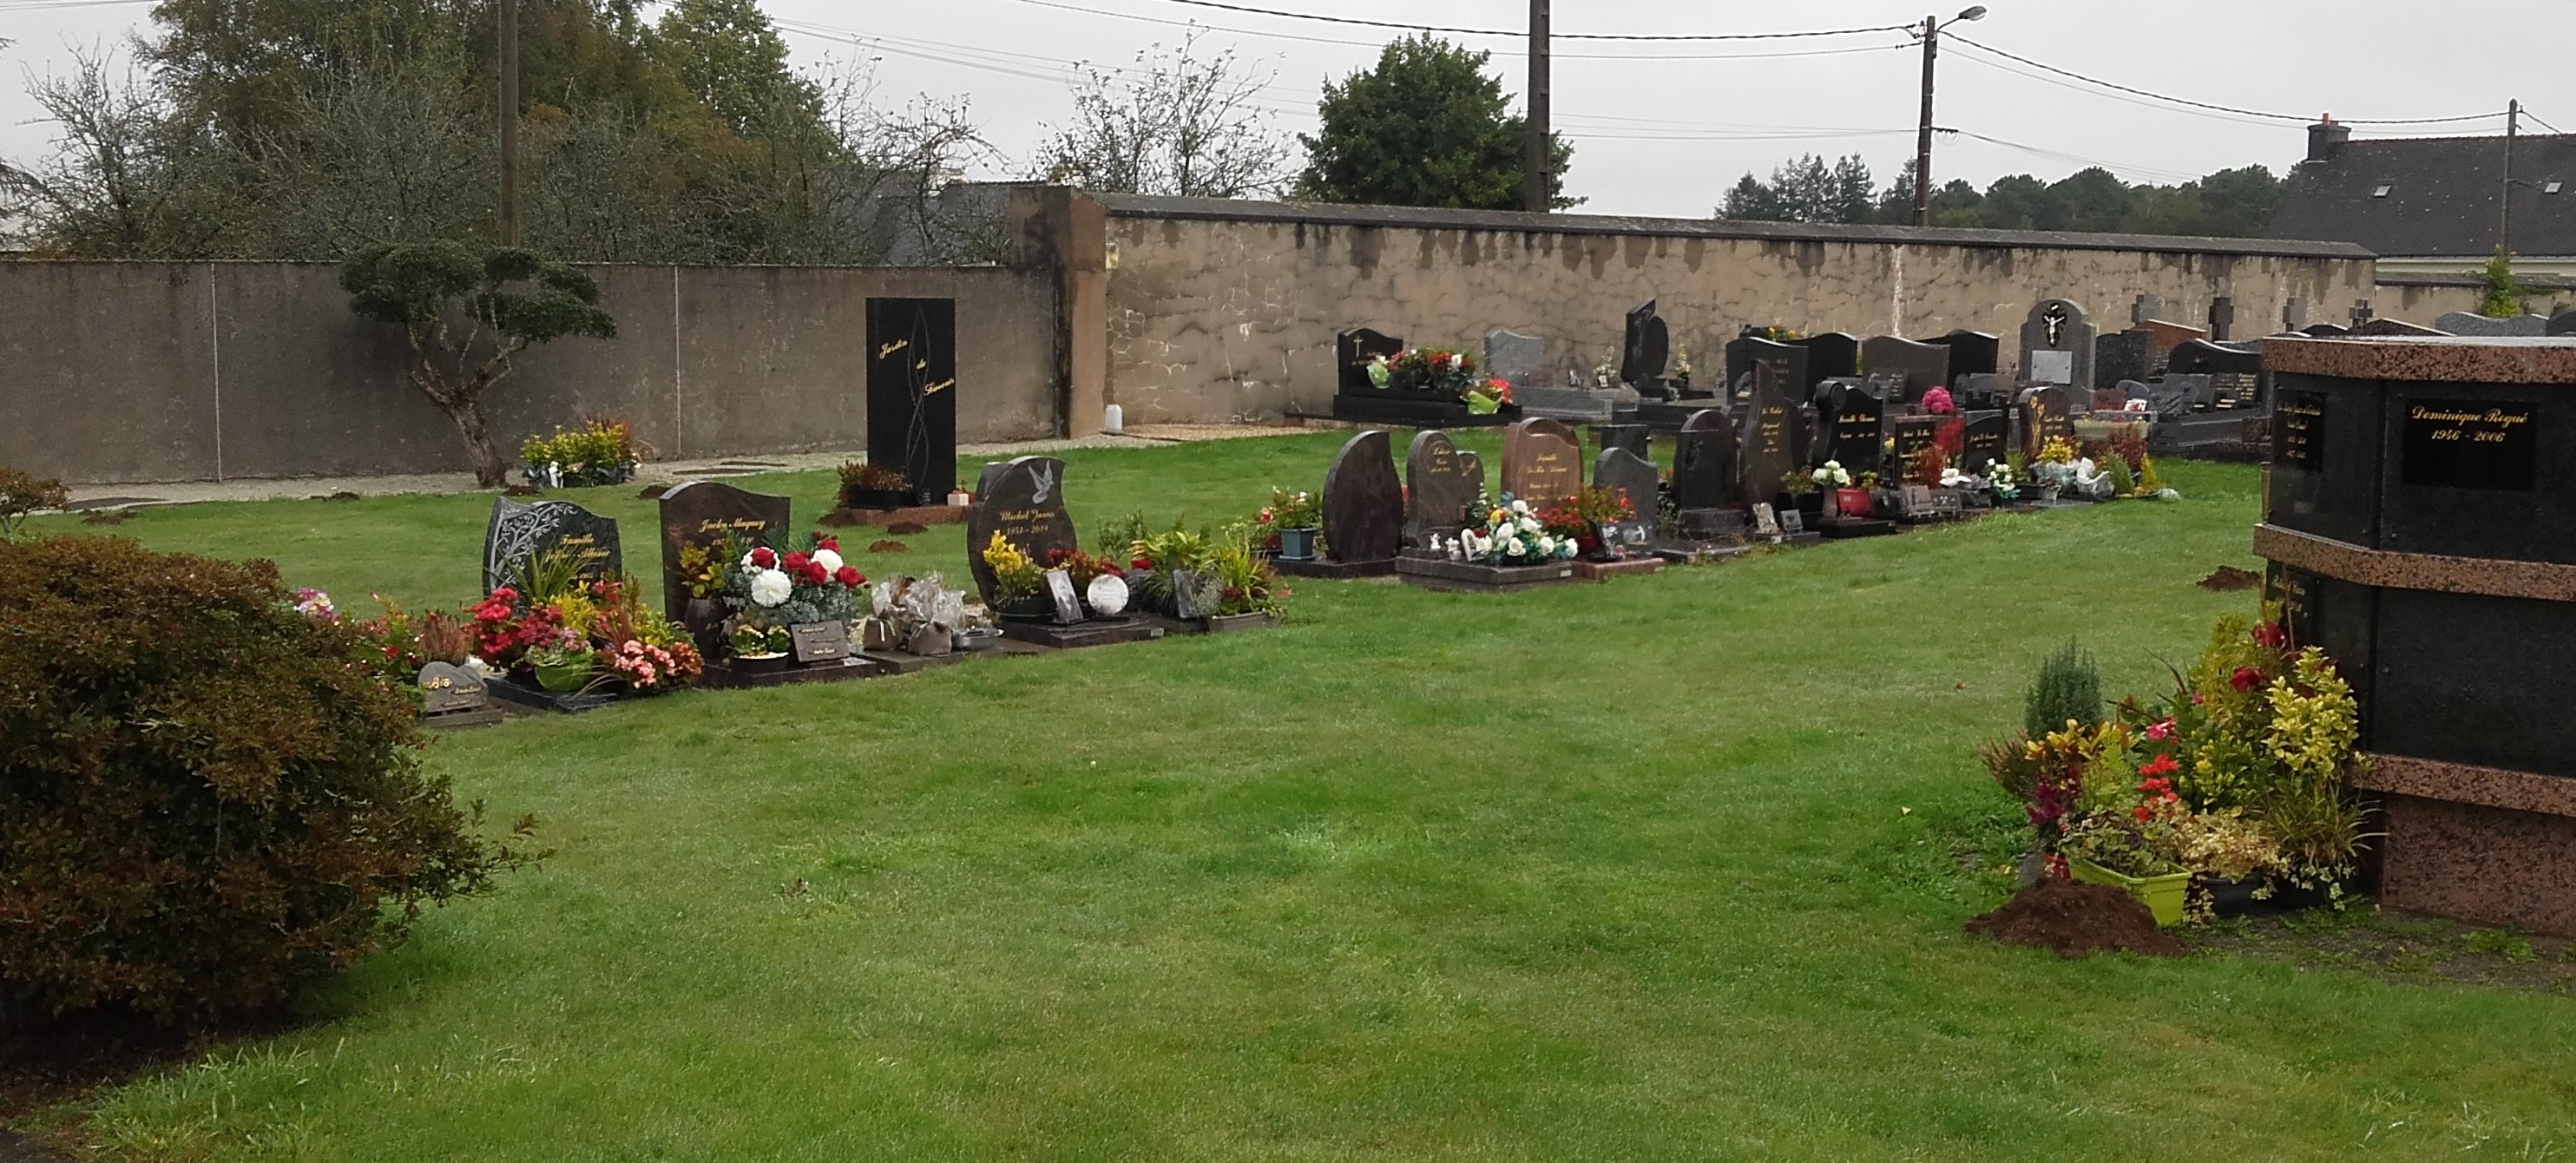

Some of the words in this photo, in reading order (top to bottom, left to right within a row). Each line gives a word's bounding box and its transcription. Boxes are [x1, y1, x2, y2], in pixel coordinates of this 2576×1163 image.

[2412, 405, 2482, 426] Dominique
[2431, 429, 2461, 440] 1946
[2474, 430, 2506, 442] 2006
[1000, 510, 1029, 522] Michel
